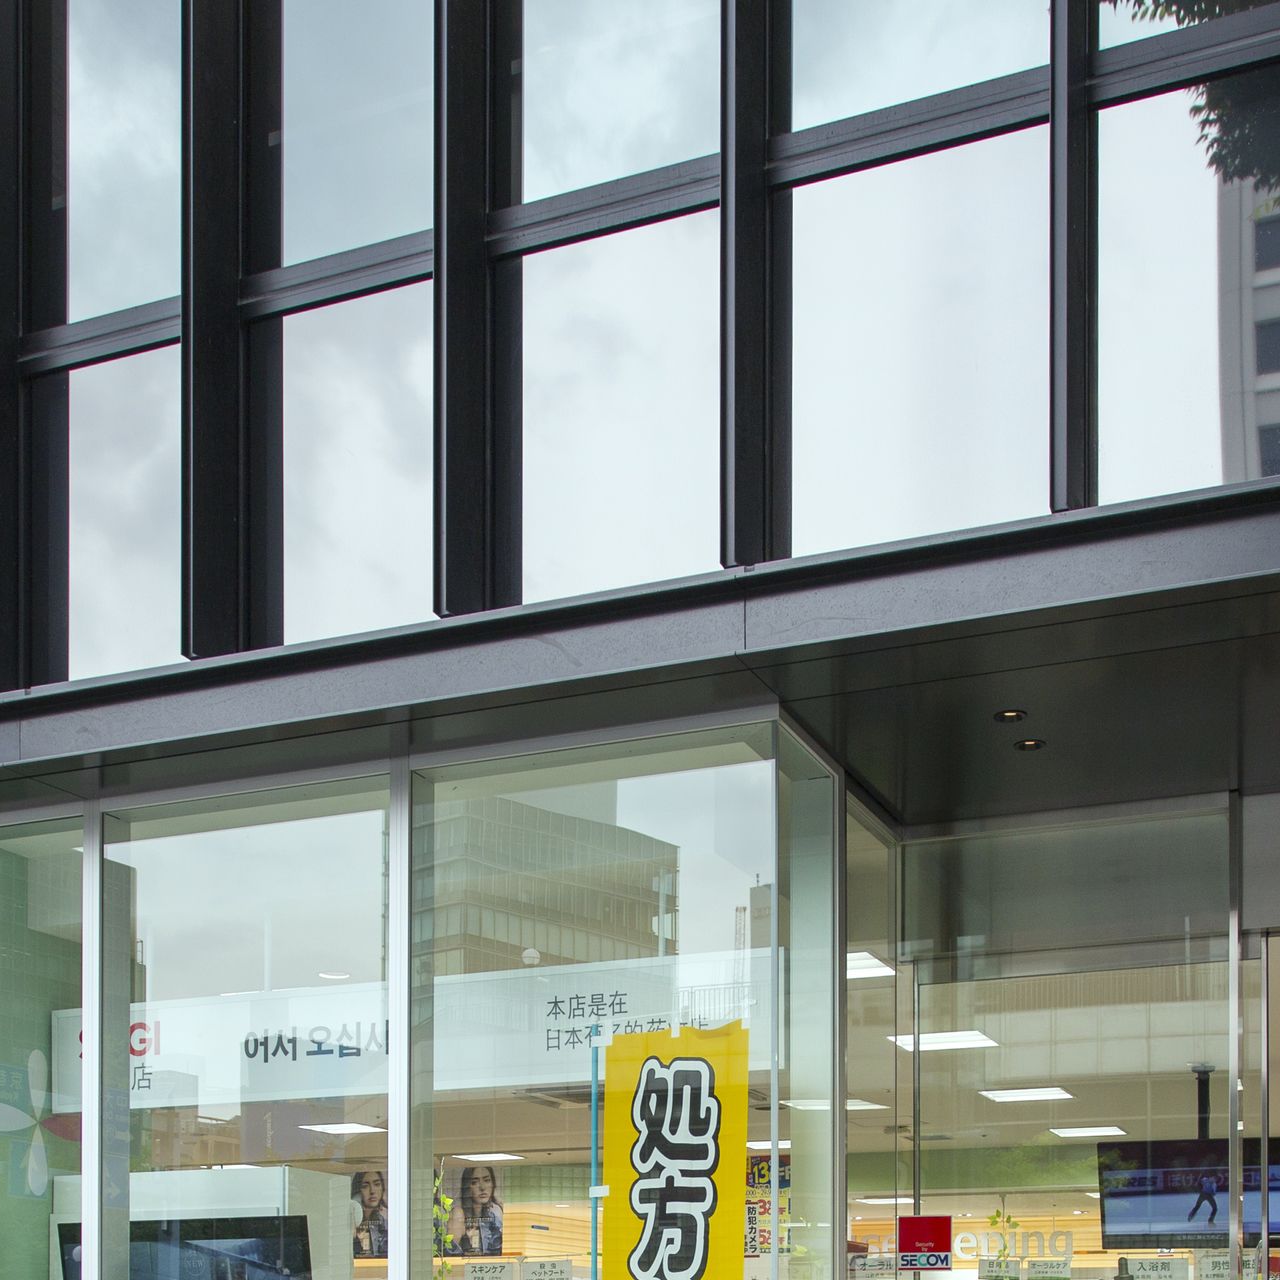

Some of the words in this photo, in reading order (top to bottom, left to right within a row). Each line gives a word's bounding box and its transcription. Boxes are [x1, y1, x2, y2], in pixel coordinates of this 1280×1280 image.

[546, 990, 628, 1021] 本店是在
[747, 1206, 757, 1254] 防犯カメラ
[900, 1253, 950, 1267] SECOM
[1031, 1261, 1068, 1270] オーラルケア
[470, 1265, 506, 1275] スキンケア
[1136, 1261, 1171, 1272] 入浴剤
[531, 1269, 566, 1277] ペットフード
